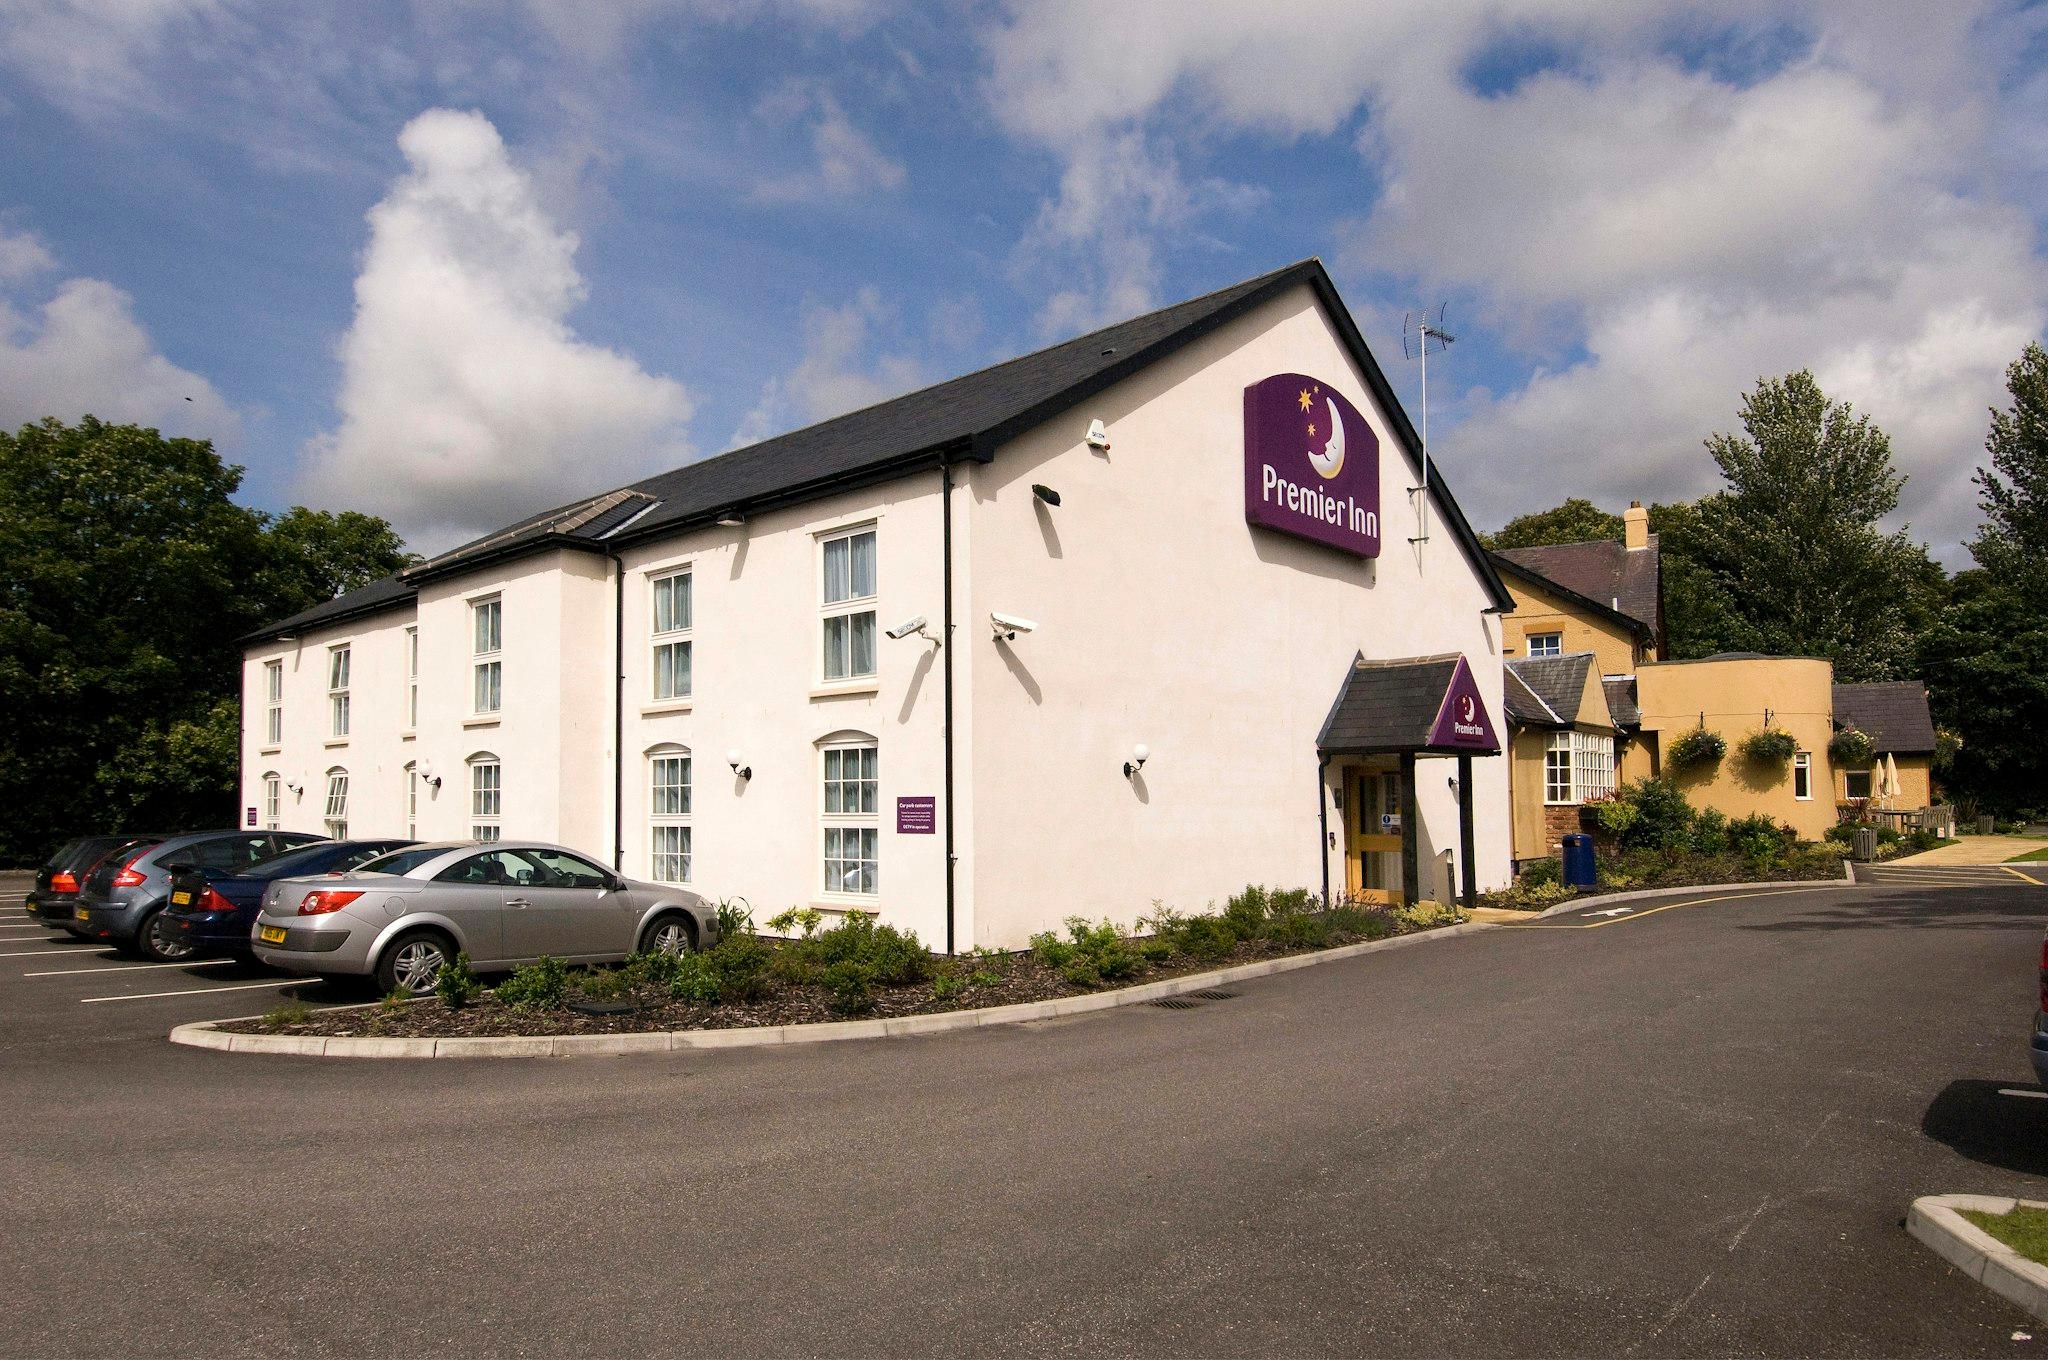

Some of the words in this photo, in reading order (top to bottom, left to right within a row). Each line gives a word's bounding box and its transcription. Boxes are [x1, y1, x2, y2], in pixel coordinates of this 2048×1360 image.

[1263, 463, 1346, 527] Premier
[1348, 496, 1378, 539] Inn
[1454, 721, 1475, 735] Premier
[1475, 724, 1484, 736] Inn
